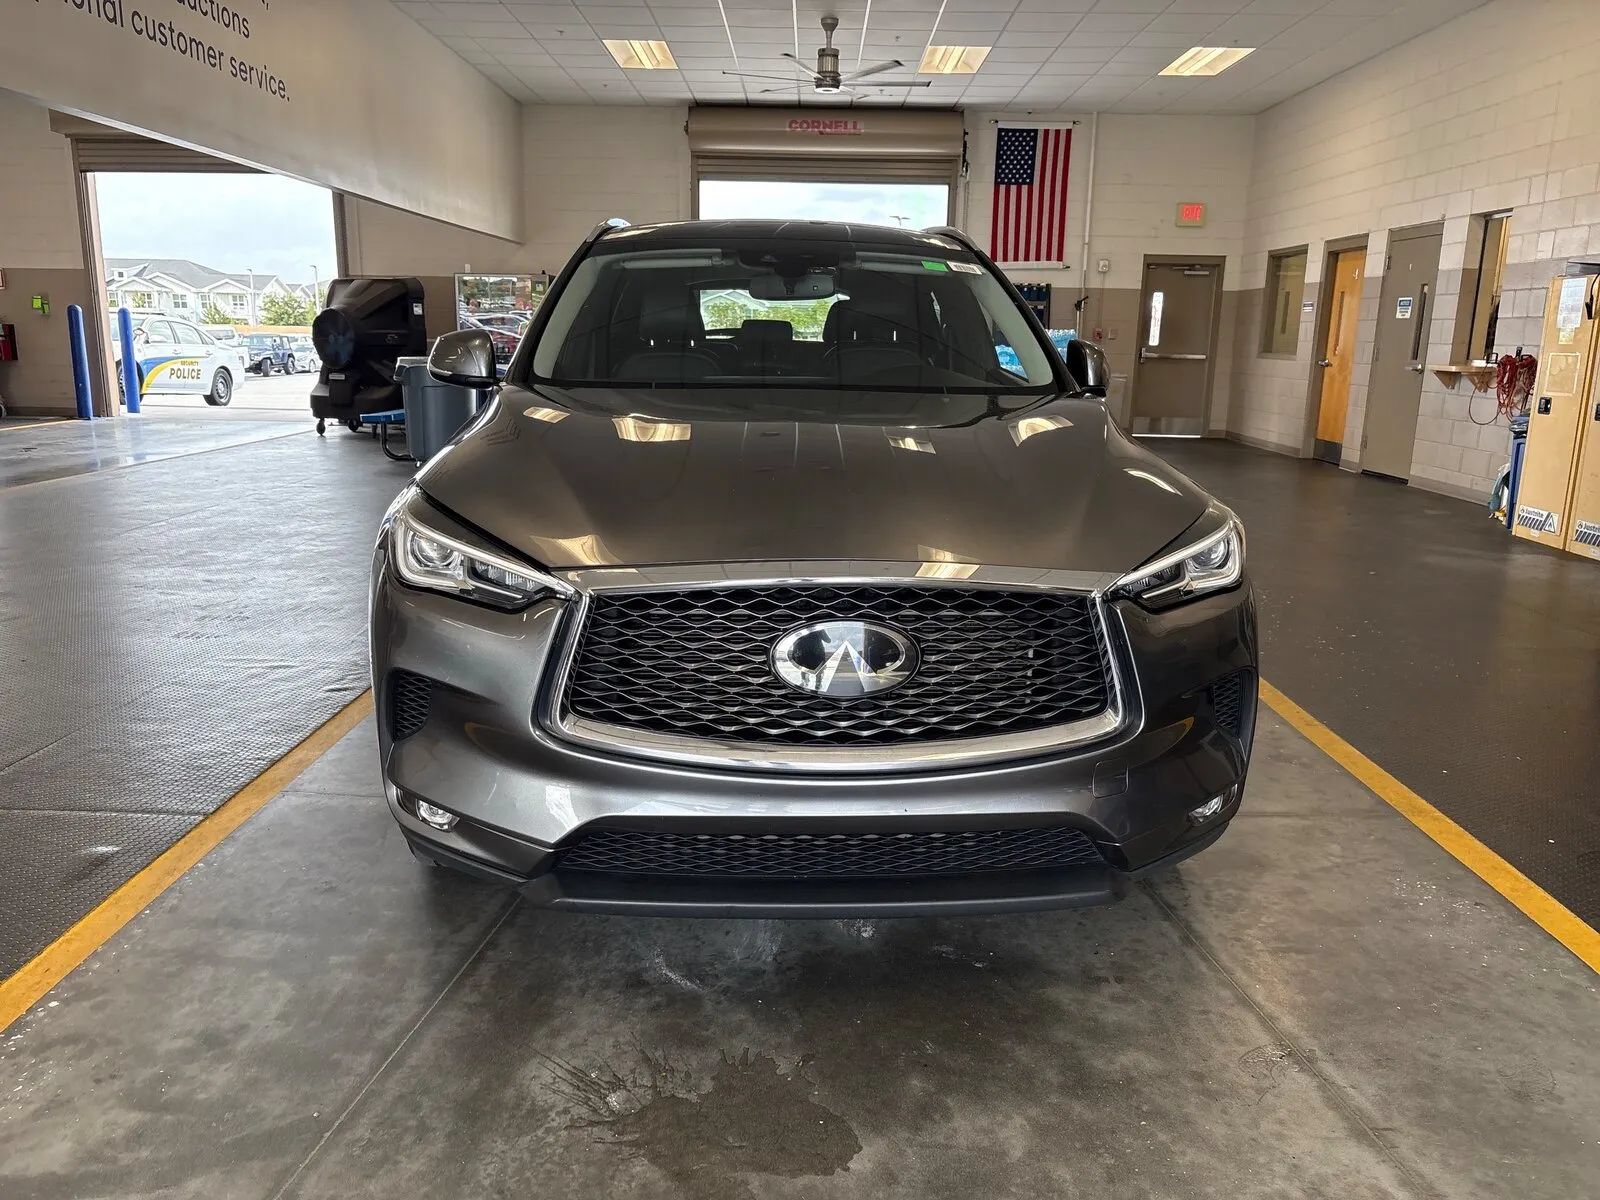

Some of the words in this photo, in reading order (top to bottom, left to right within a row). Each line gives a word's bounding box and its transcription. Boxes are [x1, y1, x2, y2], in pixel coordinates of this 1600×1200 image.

[131, 10, 224, 71] customer
[229, 55, 291, 102] service.
[788, 119, 863, 131] CORNELL
[169, 367, 201, 379] POLICE
